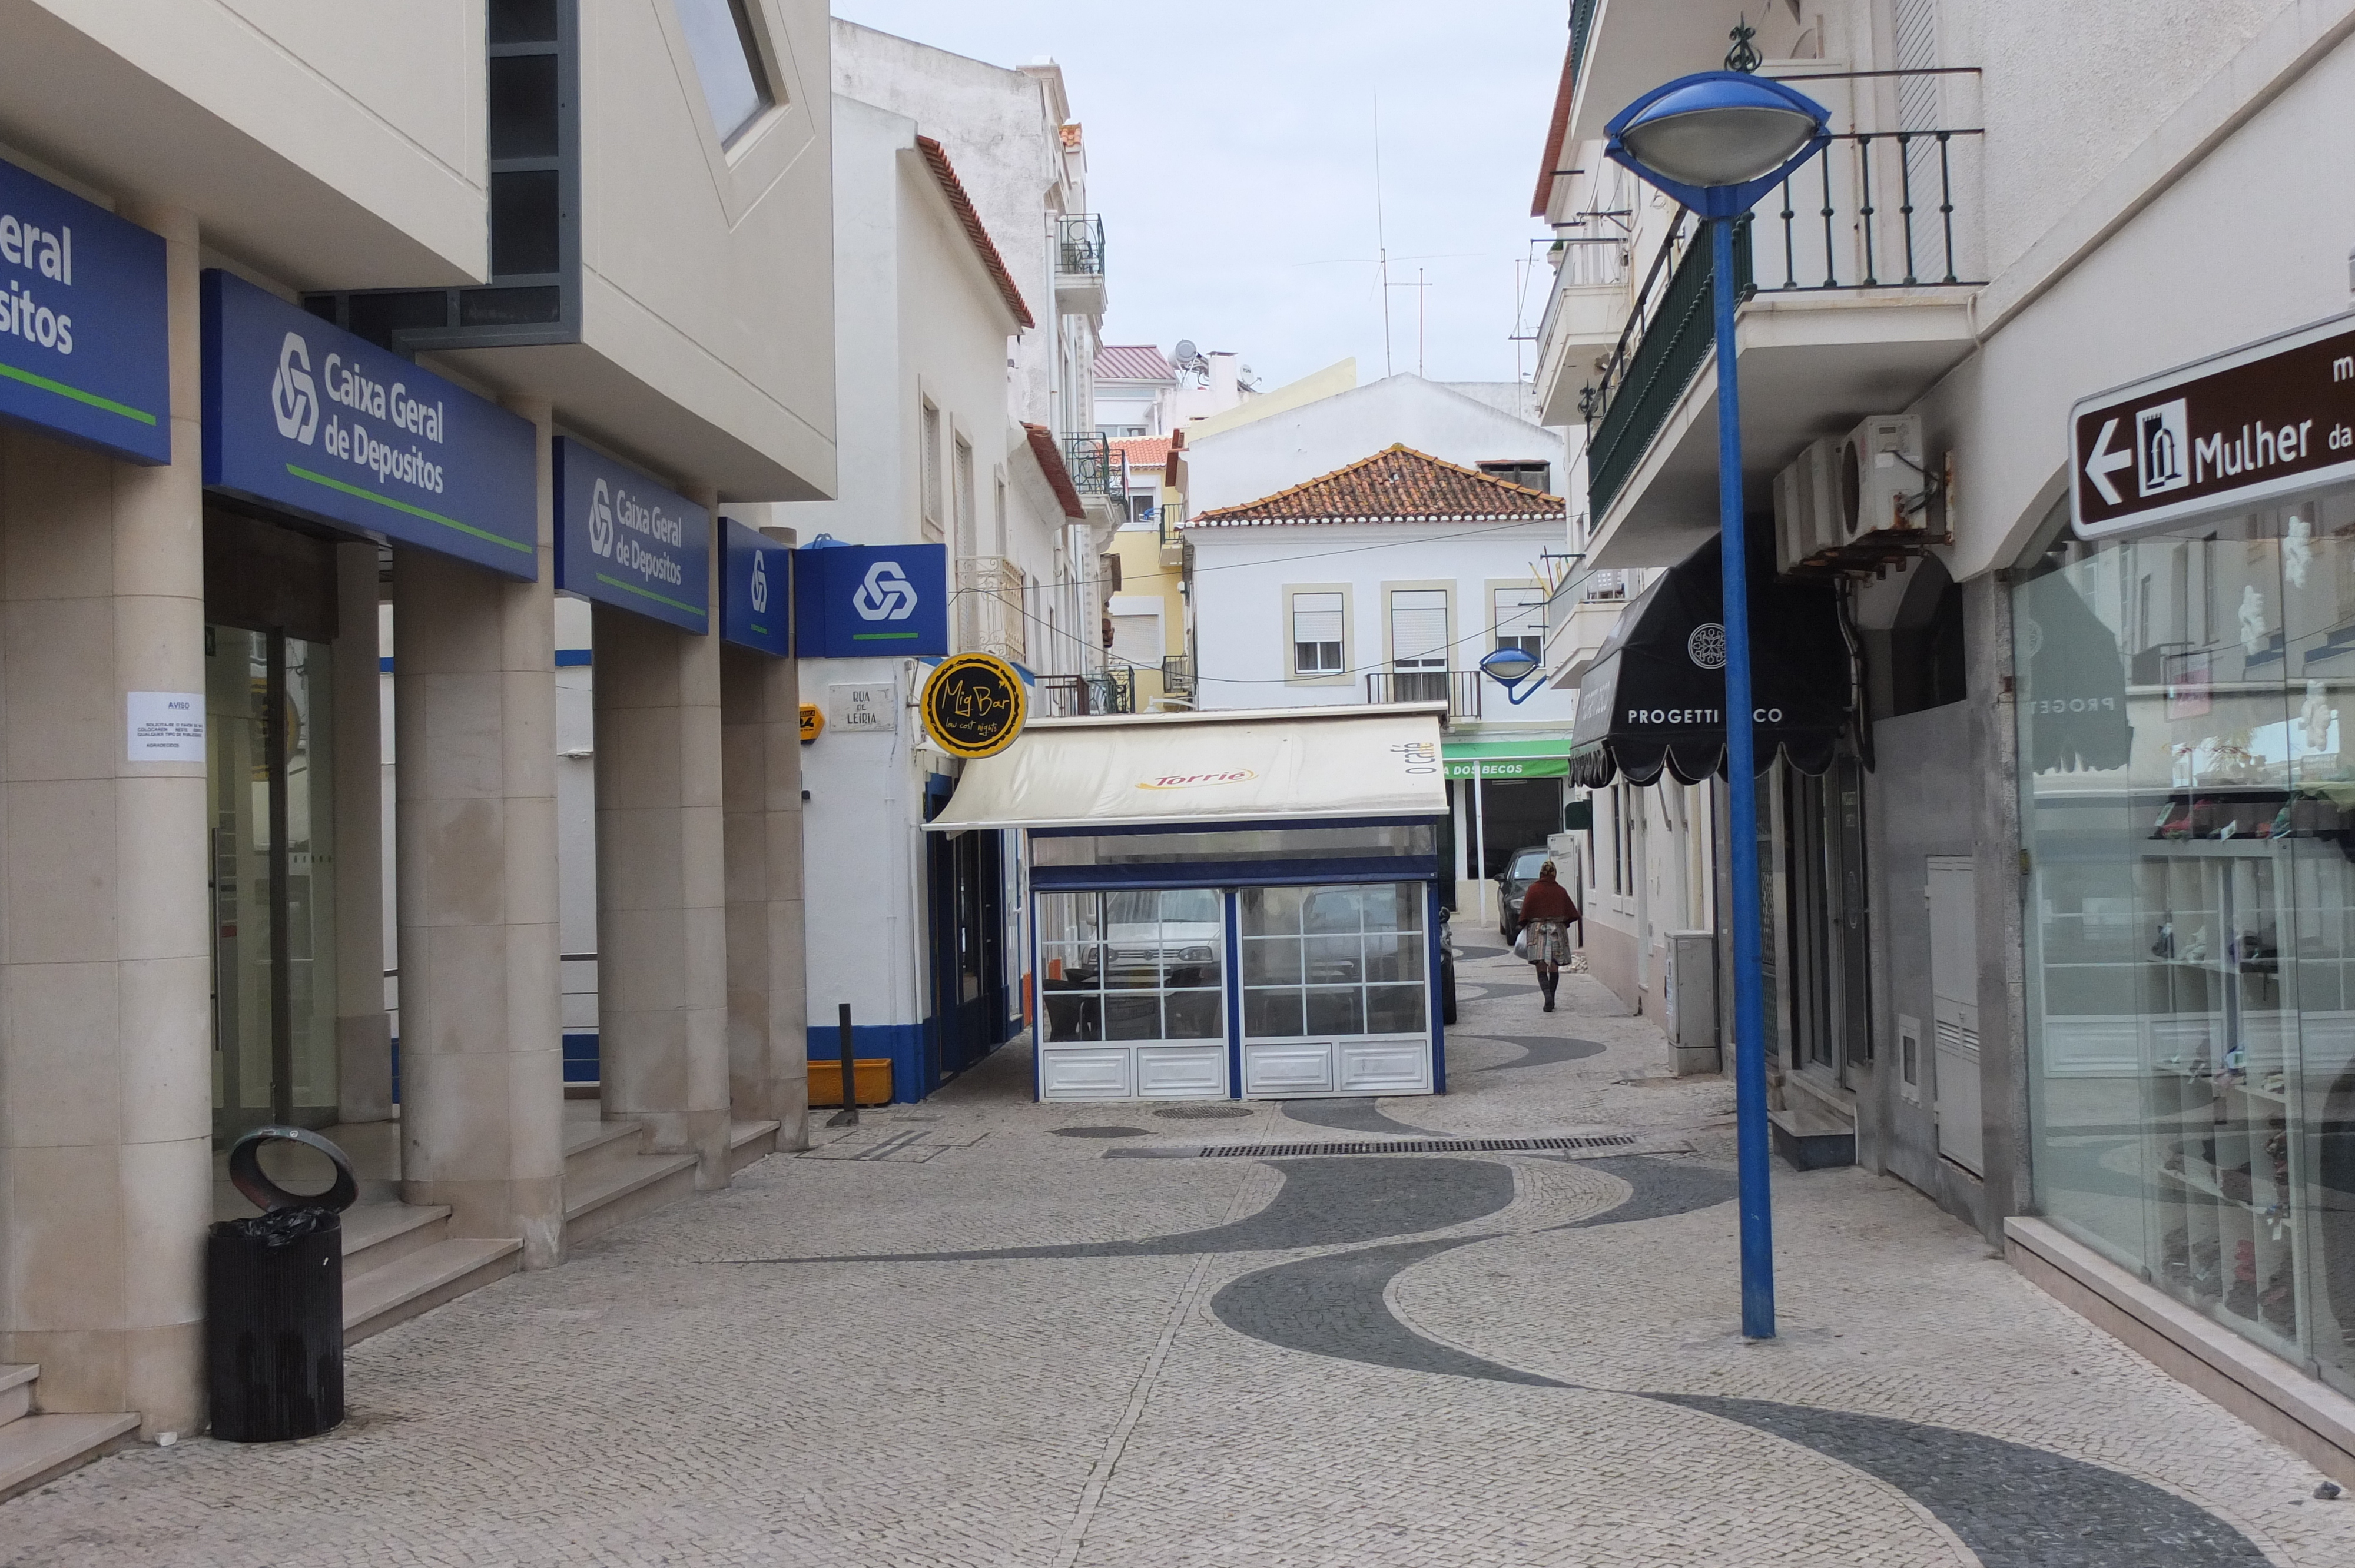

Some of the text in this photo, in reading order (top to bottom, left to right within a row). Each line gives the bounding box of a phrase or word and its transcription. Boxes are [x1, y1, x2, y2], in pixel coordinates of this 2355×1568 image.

[325, 353, 443, 444] Caixa Geral
[325, 414, 350, 460] de
[2195, 418, 2353, 484] Mulher da
[617, 490, 681, 548] Caixa Geral
[616, 534, 629, 566] de
[853, 691, 870, 702] RUA
[942, 679, 1009, 717] Mig Bar
[847, 713, 877, 724] LEIRIA
[946, 717, 957, 728] low
[959, 720, 976, 730] cost
[1628, 710, 1719, 723] PROGETTI
[1390, 742, 1435, 764] café
[1482, 765, 1523, 774] BECOS
